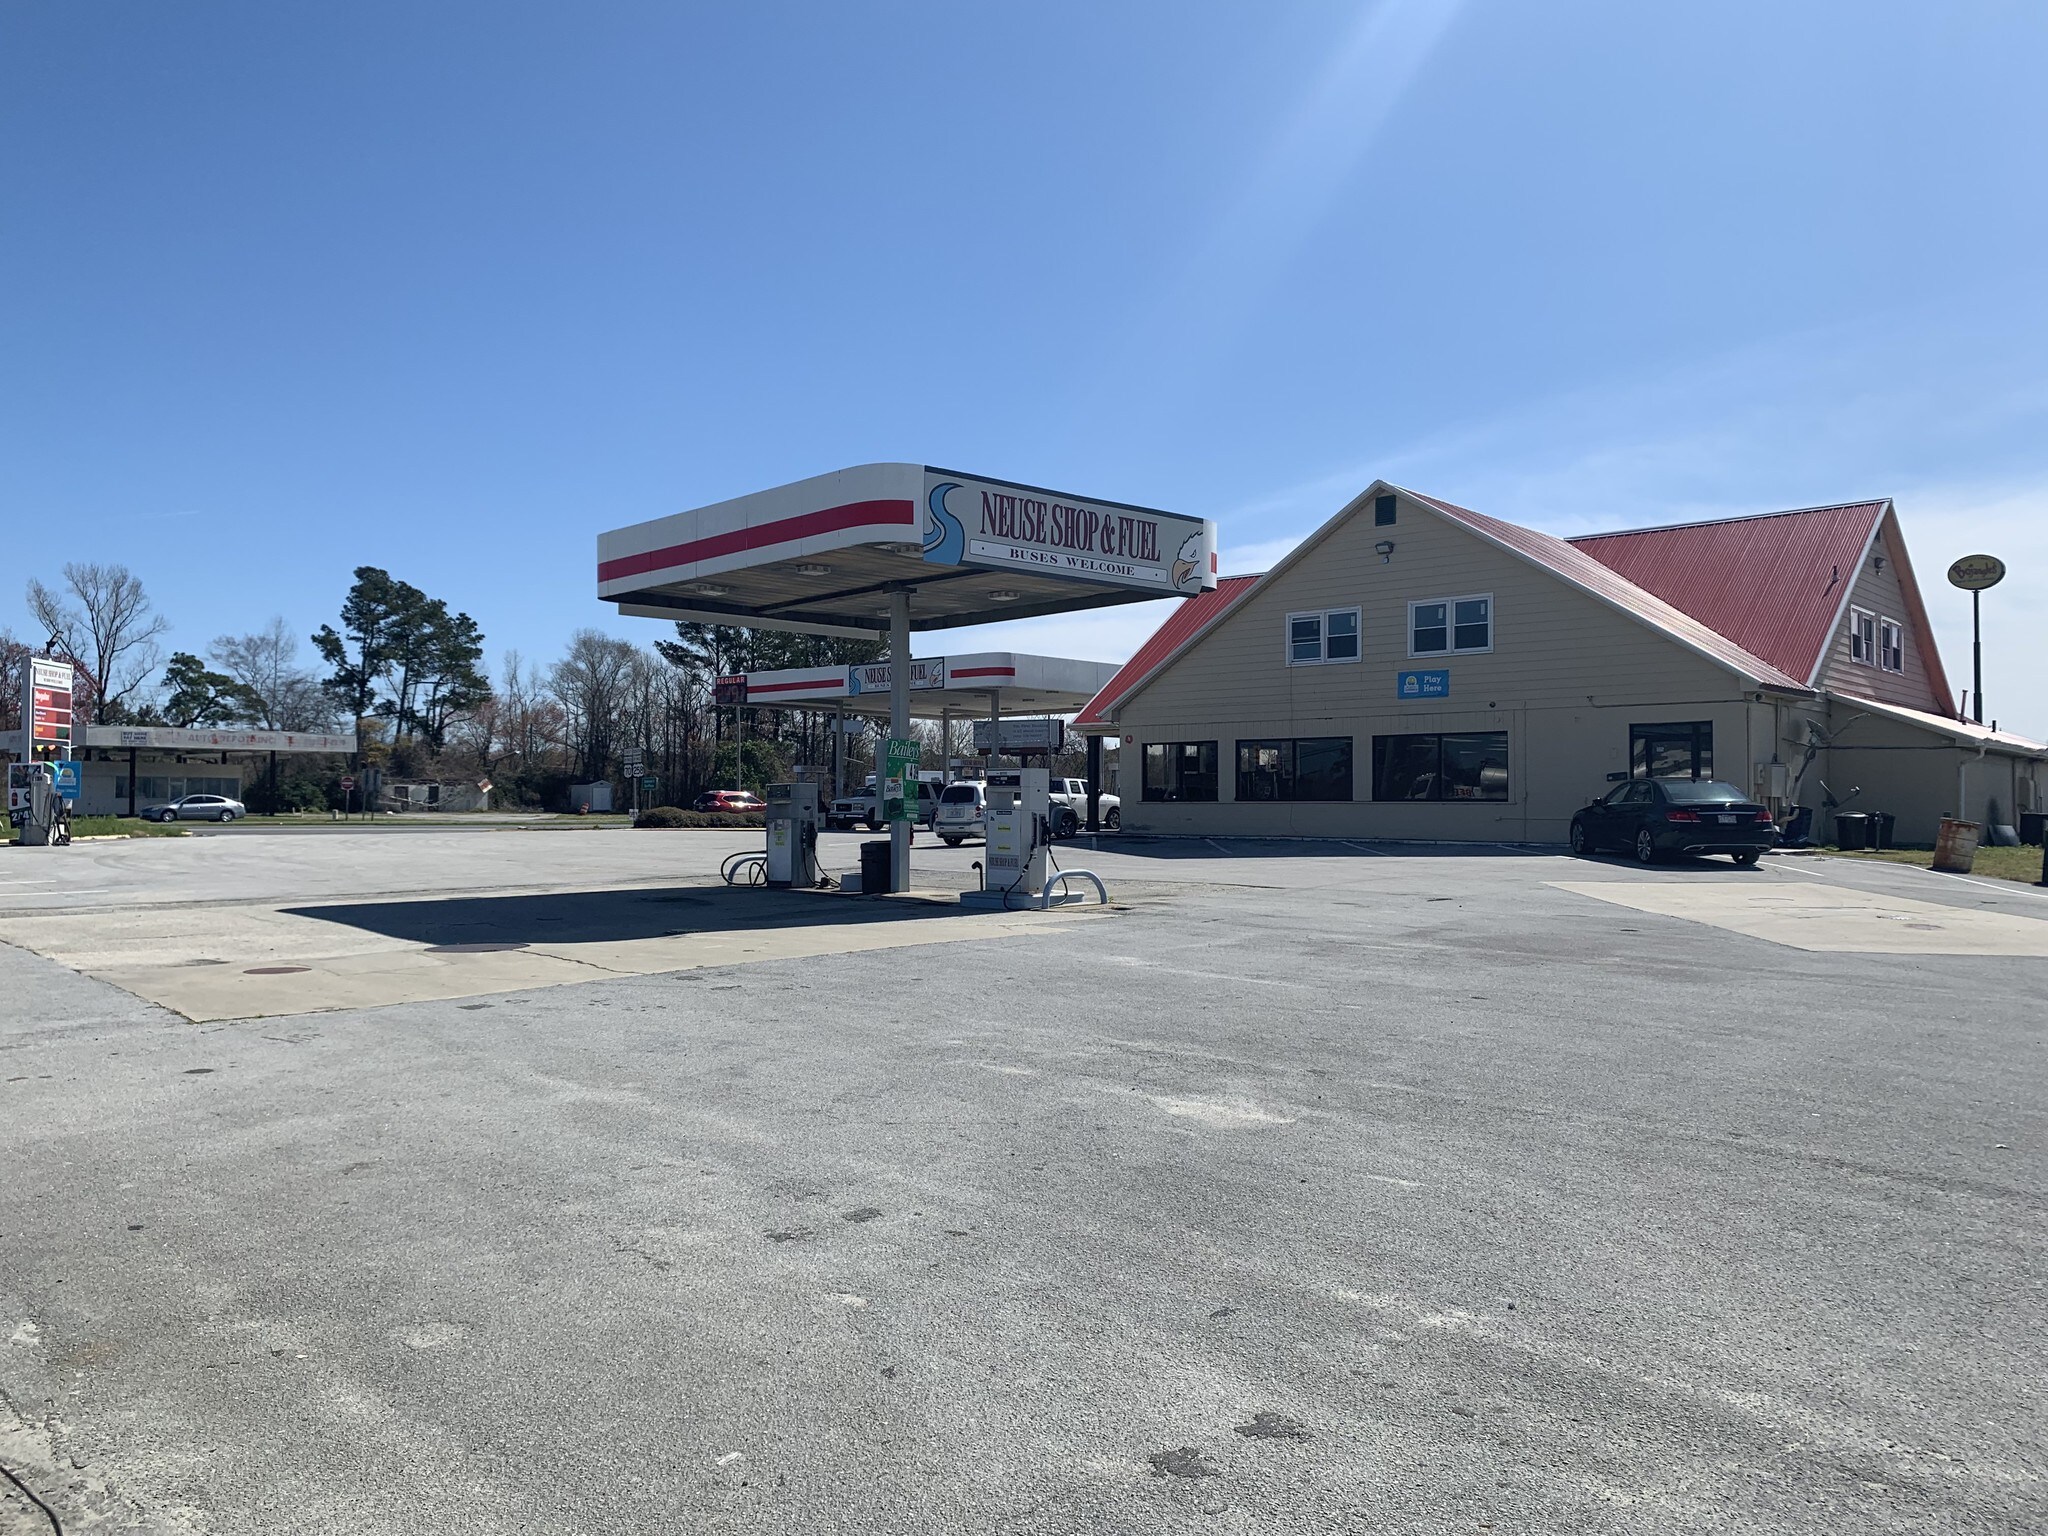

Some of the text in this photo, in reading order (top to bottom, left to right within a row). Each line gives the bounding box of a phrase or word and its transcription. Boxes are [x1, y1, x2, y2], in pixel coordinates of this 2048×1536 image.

[979, 490, 1161, 562] NEUSE SHOP & FUEL
[1009, 548, 1135, 576] BUSES WELCOME
[716, 676, 745, 685] REGULAR
[910, 664, 928, 681] FUEL
[1424, 676, 1441, 684] Play
